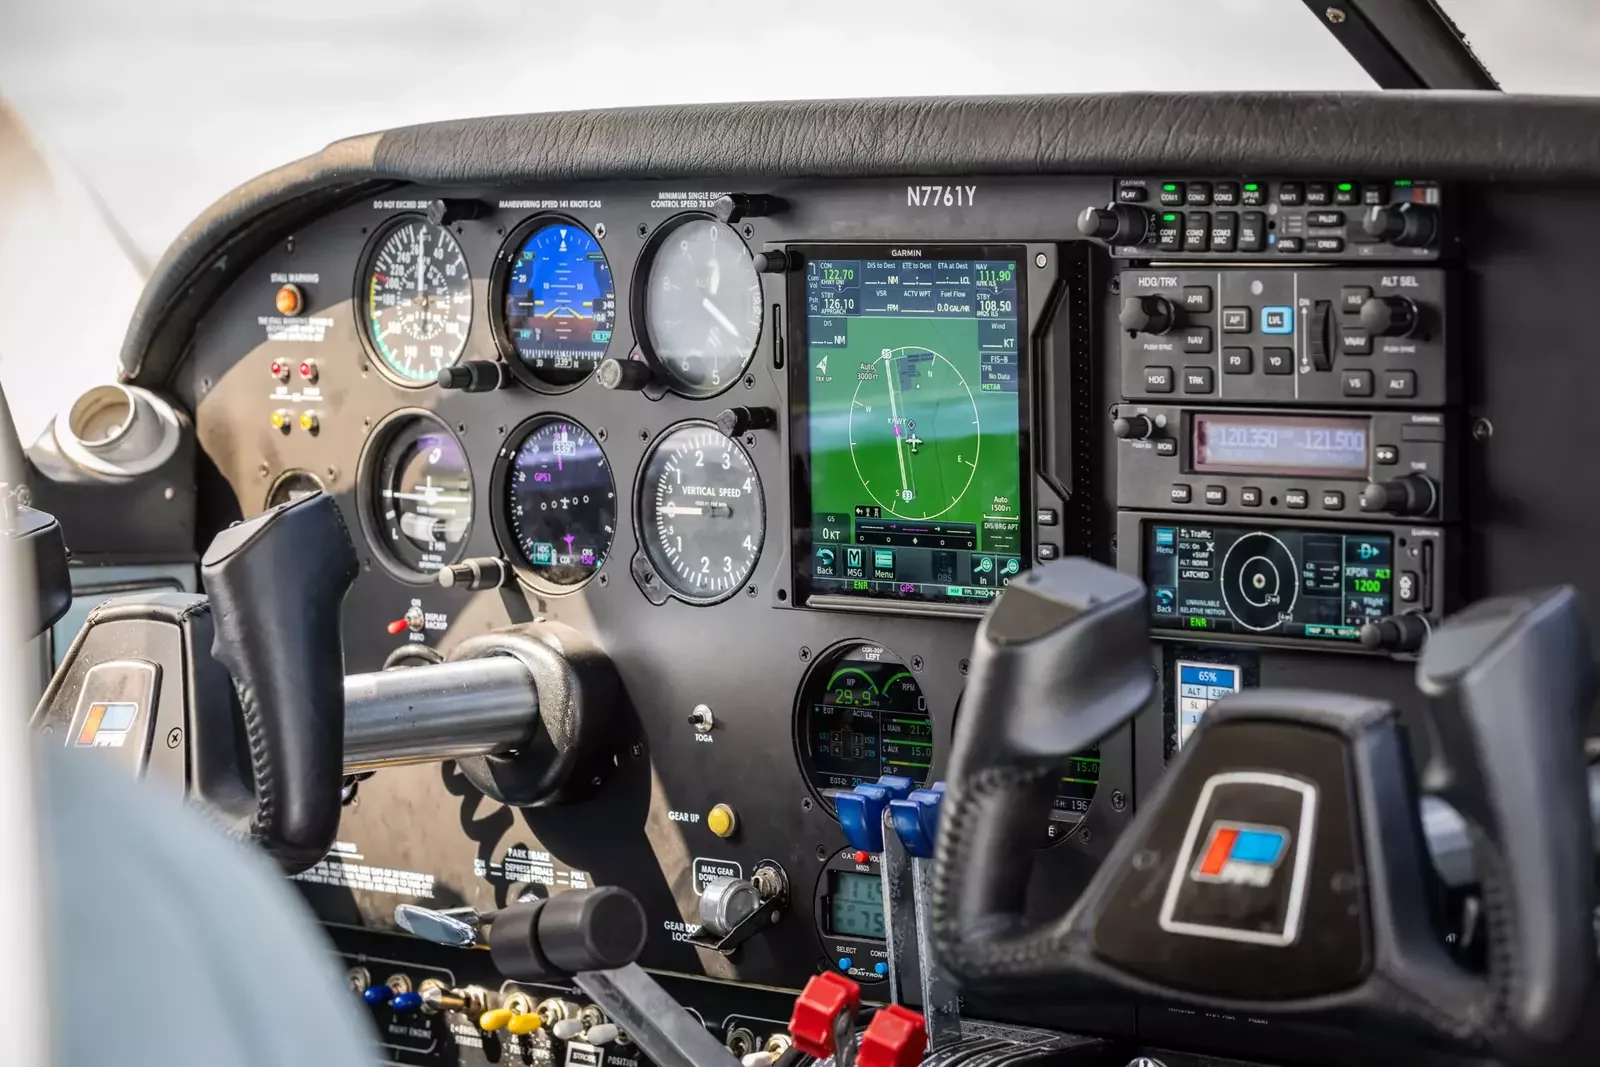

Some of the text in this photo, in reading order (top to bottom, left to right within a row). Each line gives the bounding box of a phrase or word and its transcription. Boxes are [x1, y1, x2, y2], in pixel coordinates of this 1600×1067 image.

[907, 186, 976, 206] N7761Y
[710, 226, 718, 241] 0
[434, 248, 444, 260] 40
[824, 270, 854, 280] 122.70
[888, 276, 898, 284] NM
[980, 271, 1011, 281] 111.90
[1138, 277, 1177, 287] HDG/TRK
[1381, 276, 1418, 286] ALT SEL
[824, 299, 854, 309] 126.10
[1187, 295, 1203, 304] APR
[980, 301, 1011, 311] 108.50
[834, 336, 845, 344] NM
[1004, 339, 1014, 348] KT
[1270, 357, 1281, 366] YD
[712, 370, 720, 385] 5
[1220, 428, 1364, 451] 120.350 121.500
[695, 450, 704, 466] 2
[722, 453, 730, 469] 3
[534, 473, 551, 482] GPS1
[676, 469, 680, 484] 1
[666, 485, 672, 494] .5
[742, 478, 752, 493] 4
[682, 485, 741, 498] VERTICAL SPEED
[677, 536, 682, 552] 1
[743, 535, 751, 550] 4
[701, 557, 709, 572] 2
[723, 557, 732, 572] 3
[817, 566, 833, 575] Back
[875, 570, 893, 578] Menu
[1182, 571, 1209, 579] LATCHED
[900, 584, 914, 592] GPS
[1354, 581, 1380, 592] 1200
[1190, 618, 1207, 626] ENR
[1198, 671, 1217, 682] 65%
[835, 689, 871, 706] 29.9
[695, 733, 713, 743] TOGA
[1072, 800, 1088, 810] 196
[668, 811, 700, 822] GEAR UP
[508, 848, 550, 862] PARK BRAKE
[701, 865, 734, 876] MAX GEAR
[664, 921, 683, 931] GEAR
[836, 946, 857, 954] SELECT
